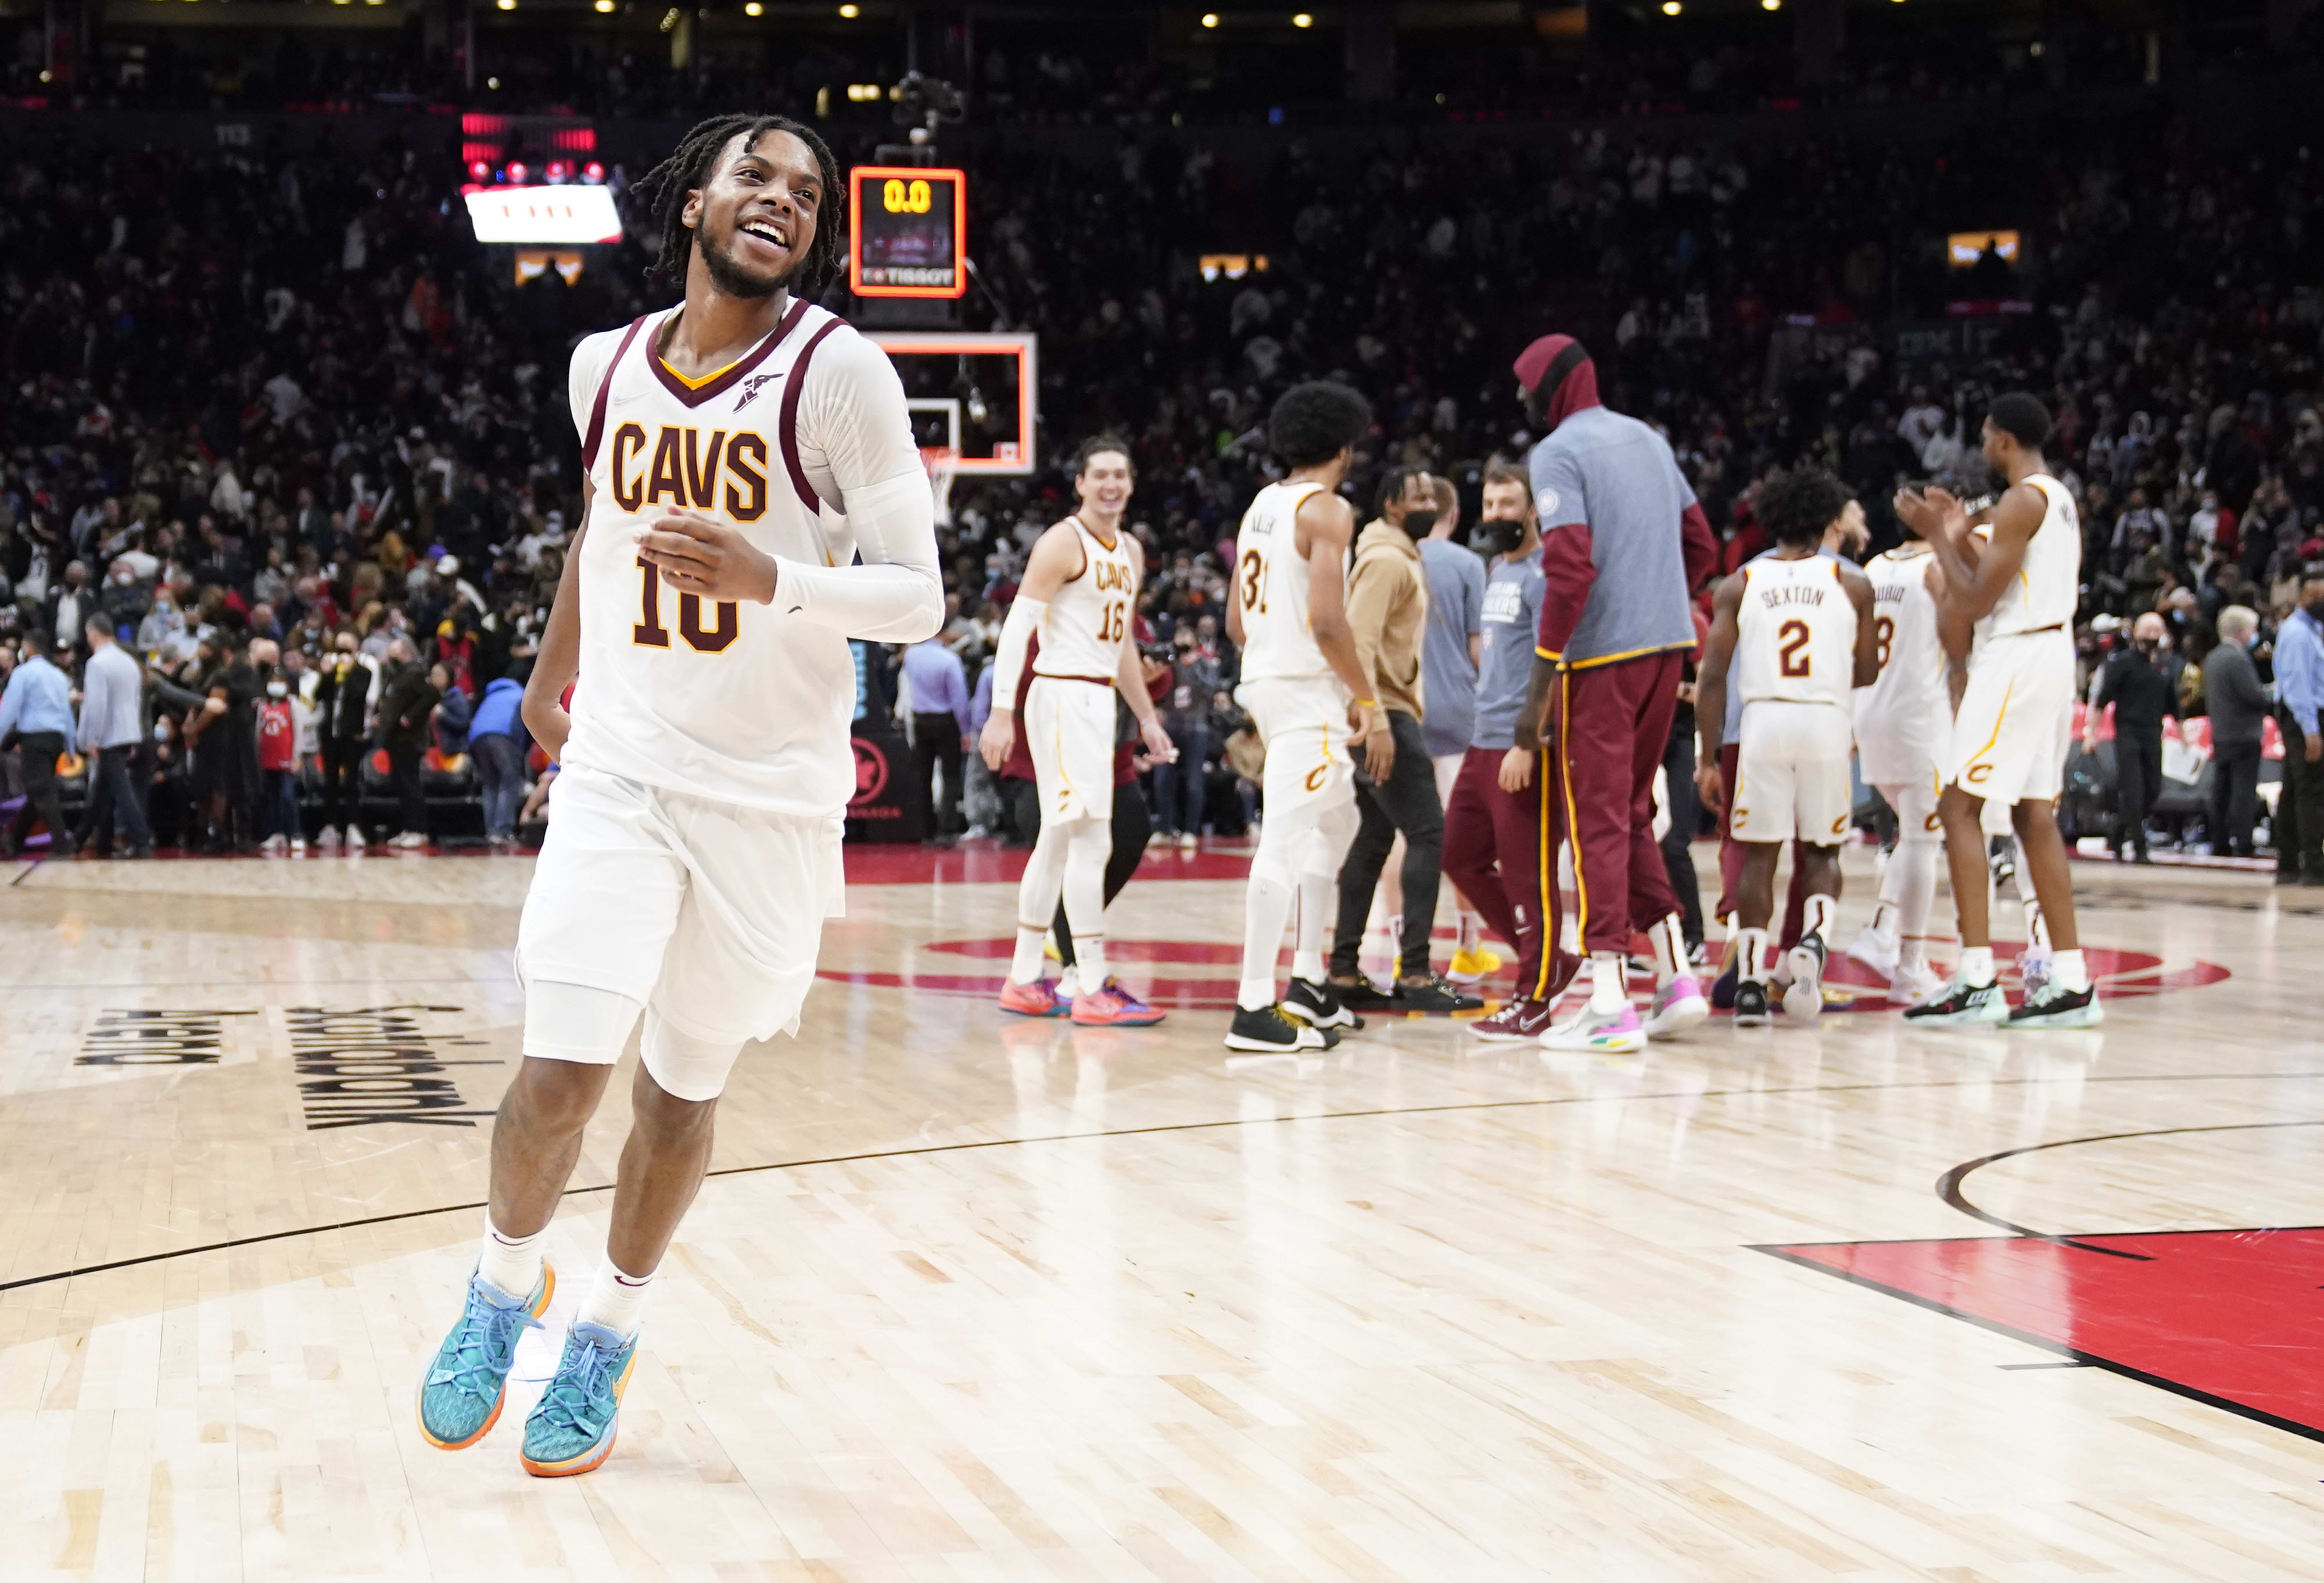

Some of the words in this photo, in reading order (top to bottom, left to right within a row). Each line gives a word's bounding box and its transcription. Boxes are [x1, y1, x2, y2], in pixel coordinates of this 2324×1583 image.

[883, 179, 931, 214] 0.0
[611, 421, 769, 523] CAVS
[1096, 560, 1132, 595] CAVS
[1241, 548, 1269, 613] 31
[1762, 586, 1824, 609] SEXTON
[1098, 600, 1124, 643] 16
[1778, 619, 1810, 677] 2
